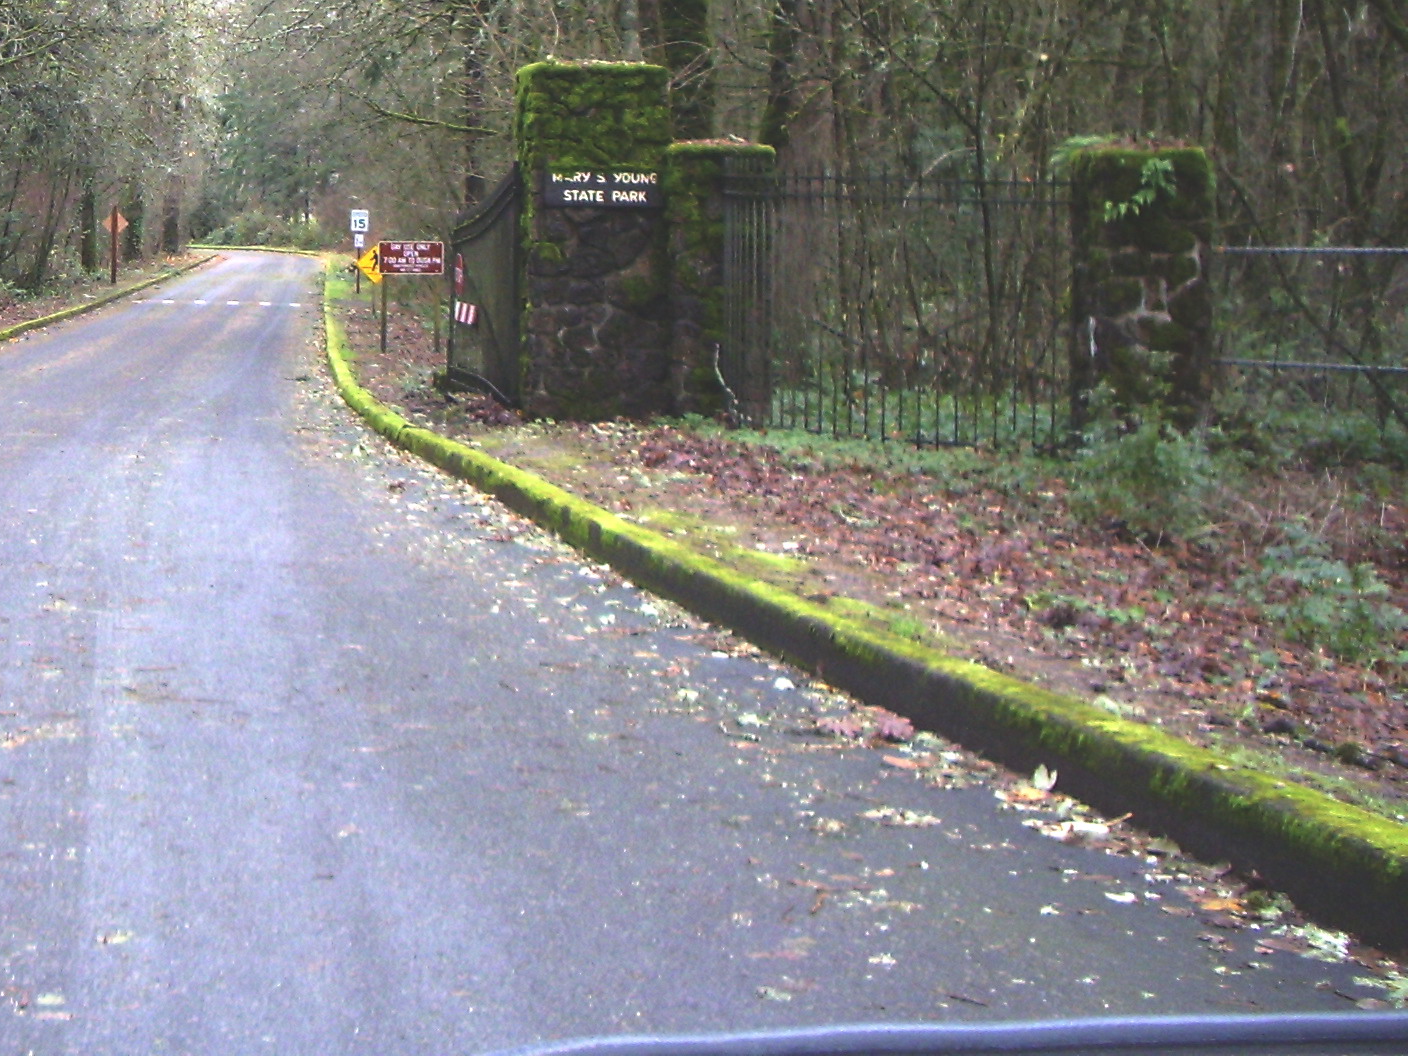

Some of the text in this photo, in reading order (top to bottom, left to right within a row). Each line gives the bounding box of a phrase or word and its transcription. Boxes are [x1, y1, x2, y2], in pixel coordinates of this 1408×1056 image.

[613, 172, 658, 184] YOUNG
[563, 189, 647, 202] STATE PARK
[353, 218, 366, 229] 15
